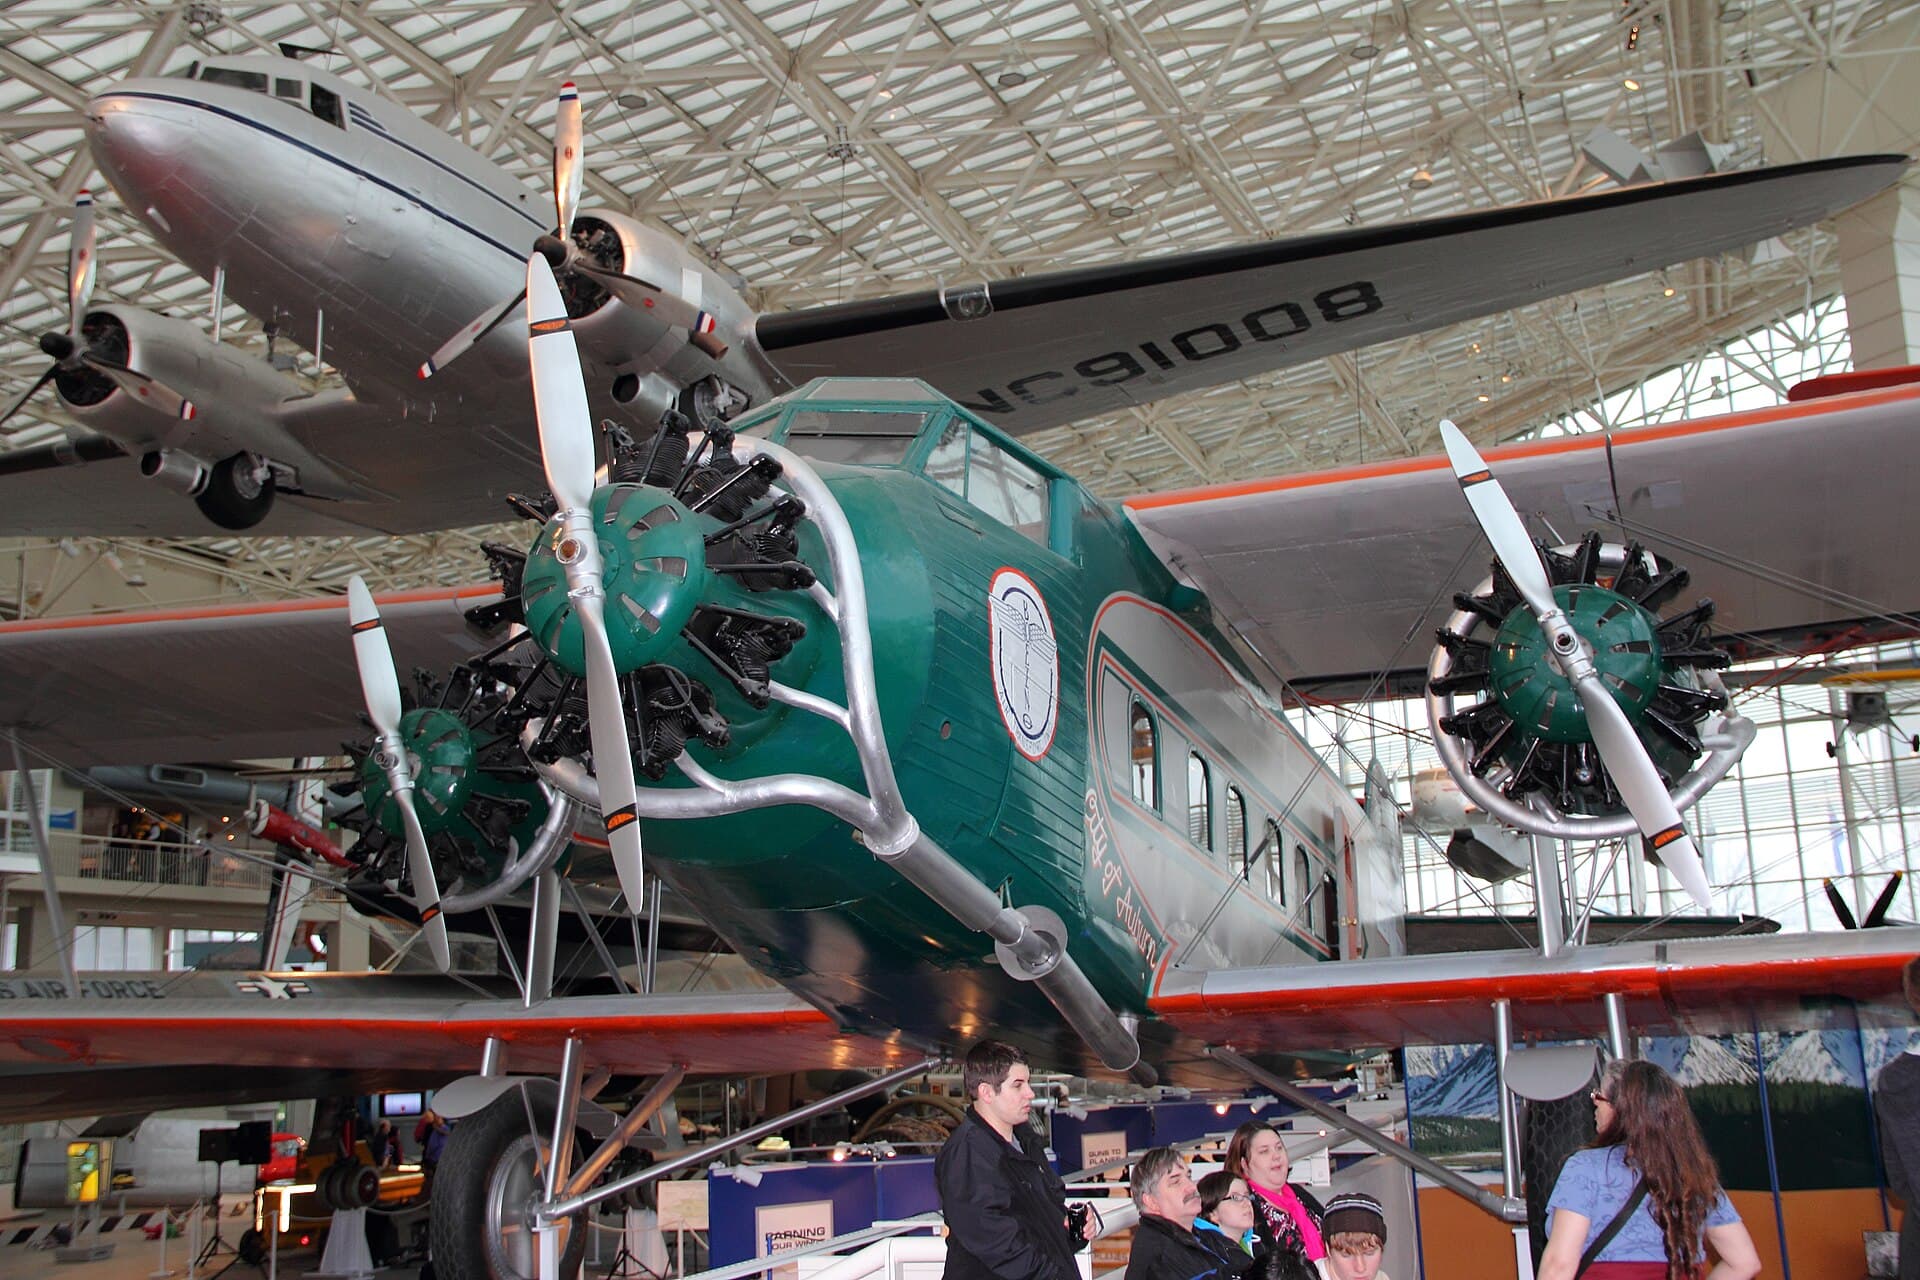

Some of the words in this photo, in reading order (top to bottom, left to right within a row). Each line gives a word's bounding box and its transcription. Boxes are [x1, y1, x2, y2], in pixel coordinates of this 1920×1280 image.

[1085, 788, 1108, 867] City
[1102, 860, 1122, 896] of
[1116, 886, 1157, 969] Auburn
[23, 980, 68, 999] AIR
[80, 980, 166, 999] FORCE
[770, 1241, 793, 1250] OUR
